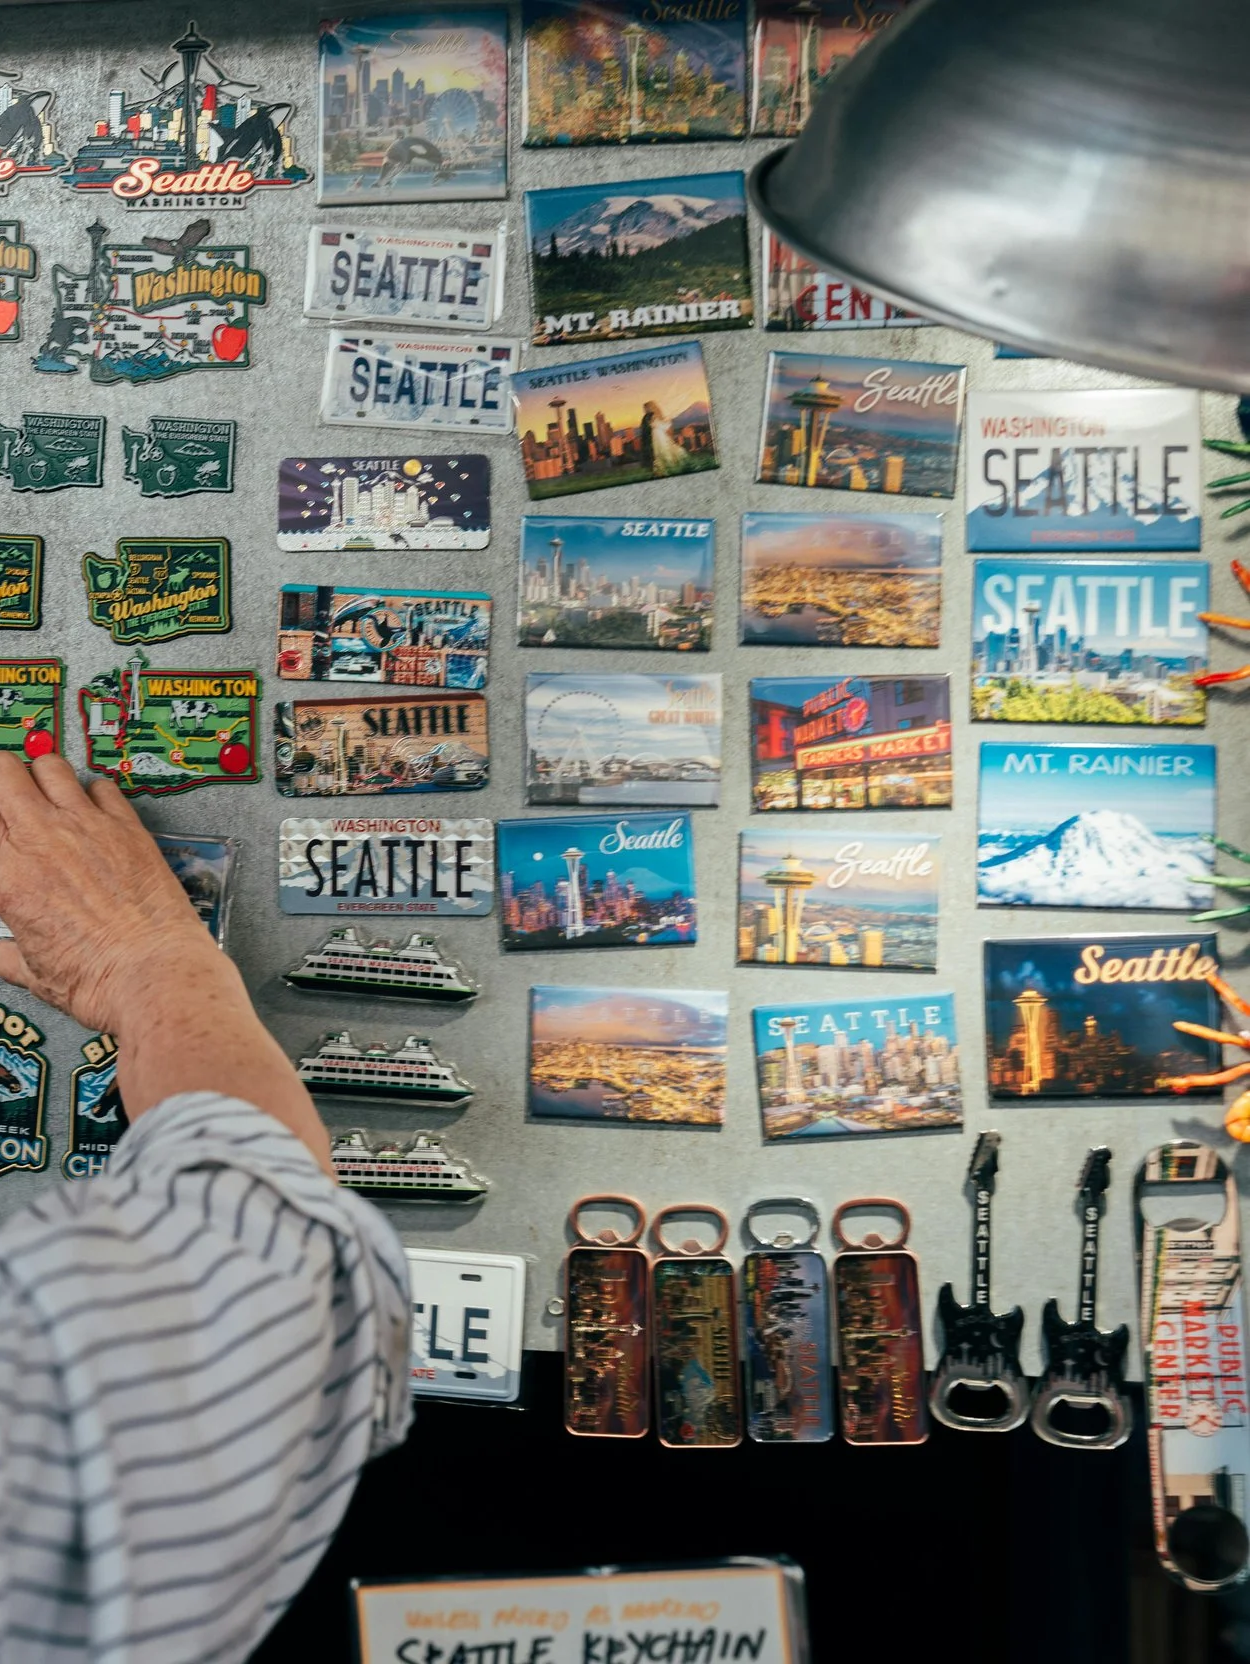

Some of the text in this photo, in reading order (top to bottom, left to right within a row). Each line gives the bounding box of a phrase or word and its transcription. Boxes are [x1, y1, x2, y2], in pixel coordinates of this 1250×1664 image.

[113, 158, 253, 200] Seattle
[125, 196, 243, 208] WASHINGTON
[375, 236, 454, 249] WASHINGTON
[134, 264, 260, 308] Washington
[330, 250, 482, 306] SEATTLE
[543, 298, 742, 336] MT. RAINIER
[395, 342, 473, 354] WASHINGTON
[350, 356, 501, 411] SEATTLE
[528, 351, 689, 391] SEATTLE WASHINGTON
[853, 366, 959, 414] Seattle
[28, 417, 100, 430] WASHINGTON
[156, 421, 230, 435] WASHINGTON
[981, 416, 1105, 439] WASHINGTON
[352, 459, 401, 473] SEATTLE
[982, 445, 1189, 518] SEATTLE
[621, 521, 710, 539] SEATTLE
[108, 584, 219, 621] Washington
[414, 600, 479, 619] SEATTLE
[981, 574, 1199, 639] SEATTLE
[147, 679, 258, 697] WASHINGTON
[803, 677, 853, 718] PUBLIC
[363, 704, 470, 736] SEATTLE
[793, 708, 845, 745] MARKET
[802, 731, 951, 767] FARMERS MARKET
[1003, 753, 1196, 777] MT. RAINIER
[331, 818, 441, 833] WASHINGTON
[600, 818, 684, 854] Seattle
[305, 838, 474, 898] SEATTLE
[827, 841, 934, 889] Seattle
[337, 902, 438, 912] EVERGREEN STATE
[327, 957, 434, 972] SEATTLE WASHINGTON
[1074, 943, 1218, 985] Seattle
[768, 1004, 942, 1037] SEATTLE
[322, 1059, 429, 1073] SEATTLE WASHINGTON
[335, 1163, 442, 1173] SEATTLE WASHINGTON
[976, 1190, 990, 1305] SEATTLE
[1081, 1206, 1099, 1321] SEATTLE
[1182, 1299, 1215, 1401] MARKET
[799, 1342, 821, 1425] SEATTLE
[1153, 1320, 1183, 1418] CENTER
[1217, 1324, 1248, 1415] PUBLIC
[395, 1627, 768, 1664] SEATTLE KEYCHAIN
